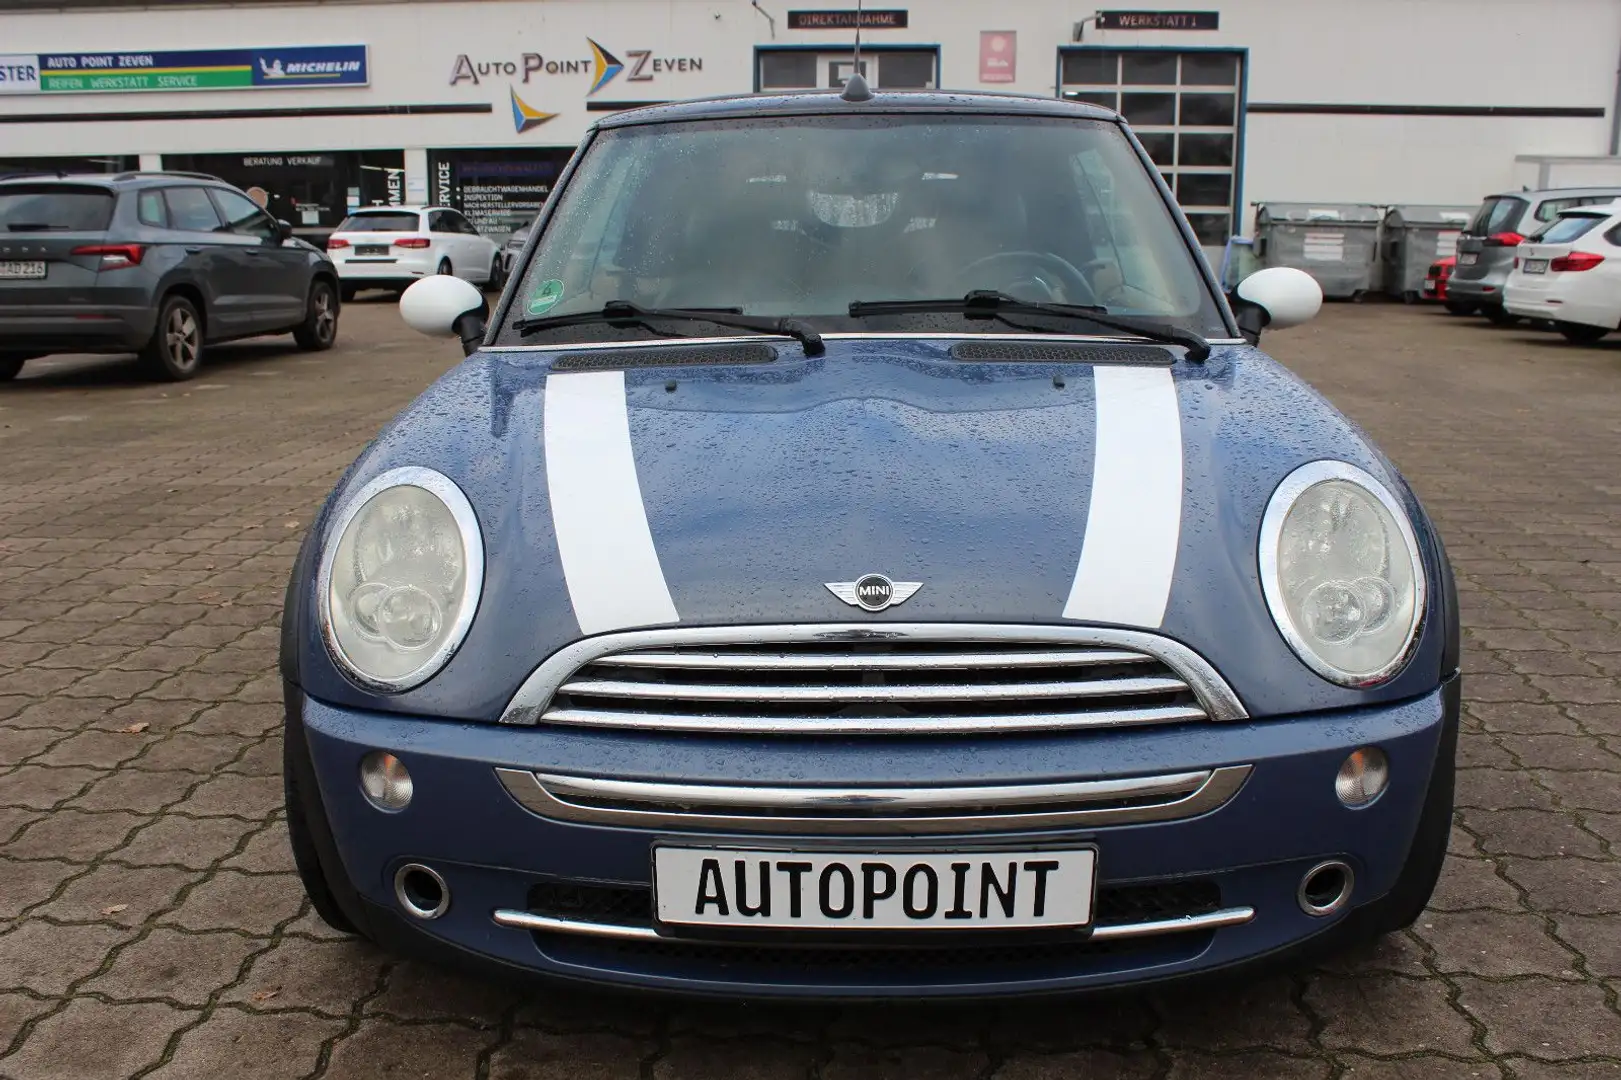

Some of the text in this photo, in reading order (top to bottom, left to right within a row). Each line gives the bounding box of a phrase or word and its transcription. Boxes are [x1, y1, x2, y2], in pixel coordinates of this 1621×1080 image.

[798, 13, 896, 25] DIREKTANNAHME
[1119, 14, 1187, 26] WERKSTATT
[47, 55, 153, 68] AUTO POINT ZEVEN
[286, 61, 361, 73] MICHELIN
[48, 75, 198, 89] REIFEN WERKSTATT SERVICE
[243, 157, 283, 166] BERATUNG
[860, 585, 890, 596] MINI
[695, 858, 1059, 920] AUTOPOINT
